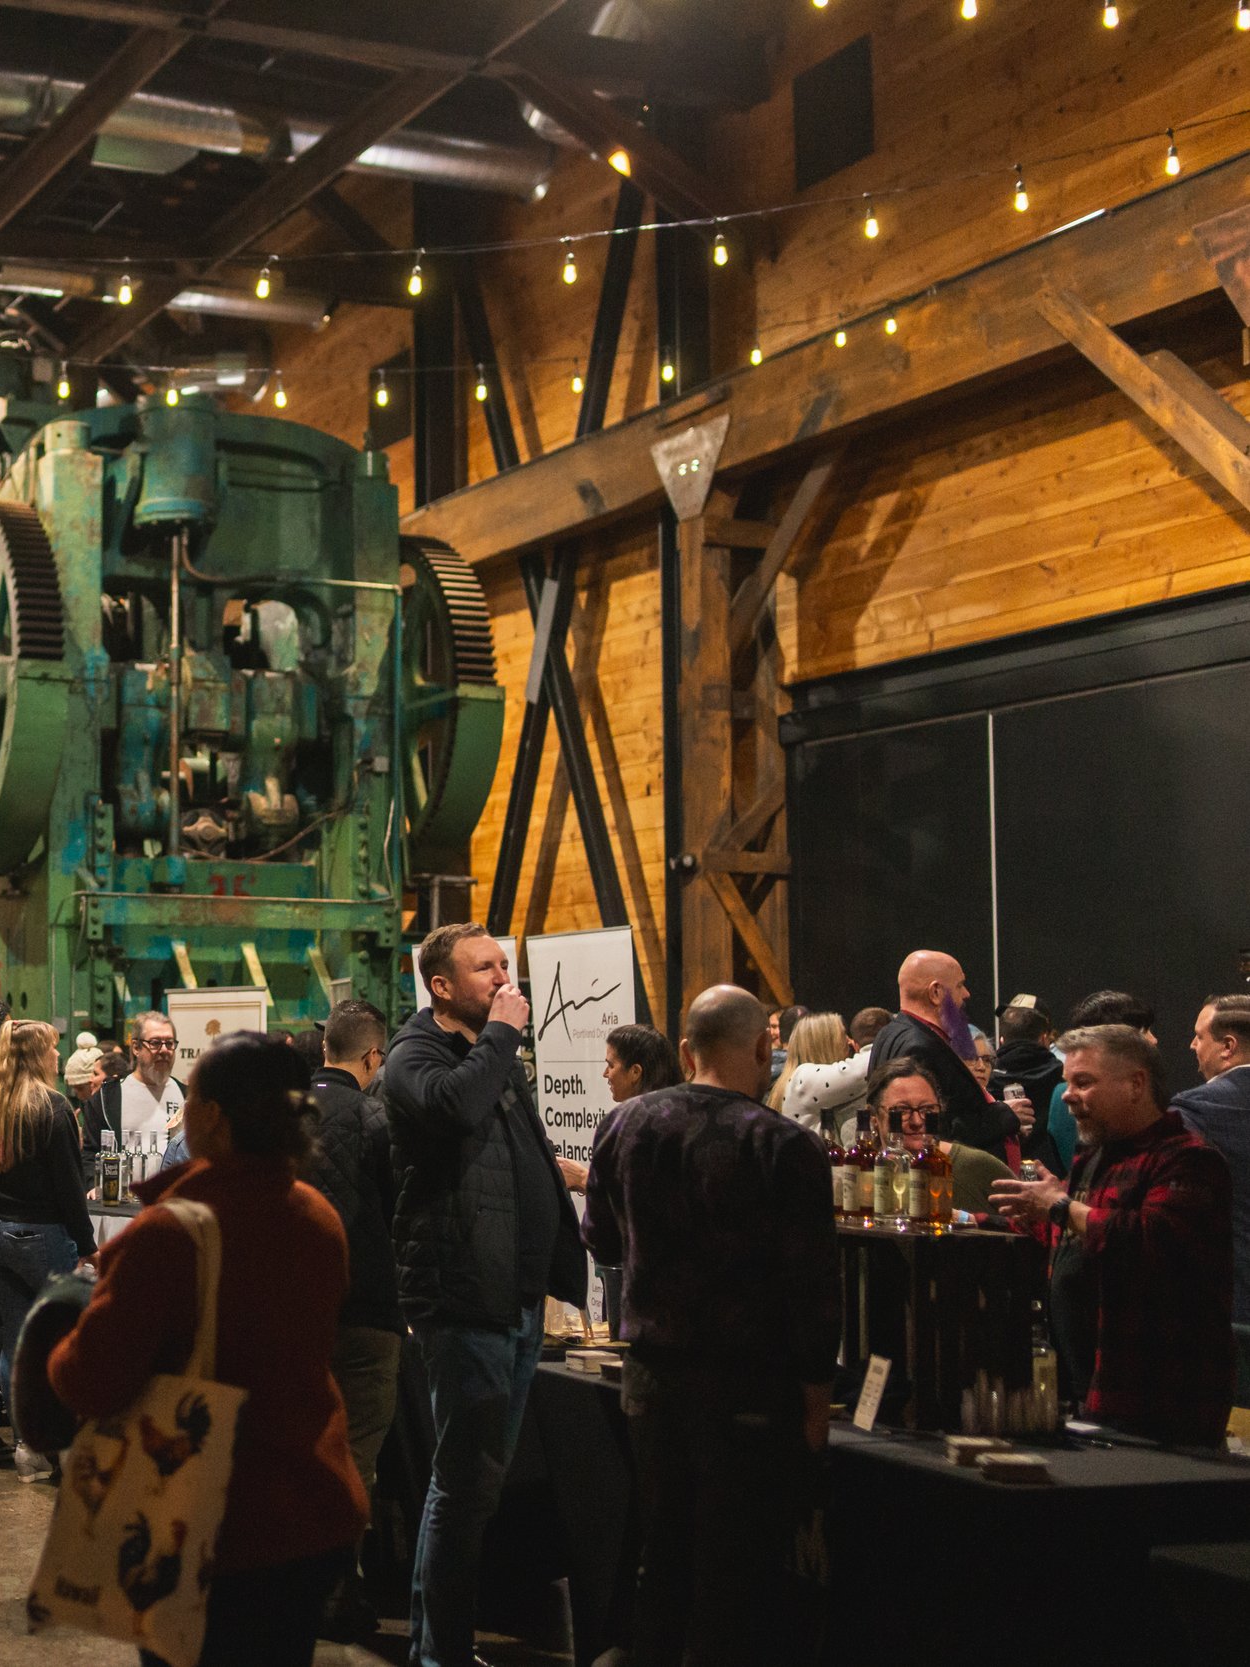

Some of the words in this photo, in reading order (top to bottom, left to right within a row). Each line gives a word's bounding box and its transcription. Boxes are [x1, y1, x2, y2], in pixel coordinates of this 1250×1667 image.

[601, 1012, 619, 1025] Aria
[180, 1048, 201, 1059] TRA
[544, 1074, 586, 1098] Depth.
[545, 1106, 606, 1132] Complexit
